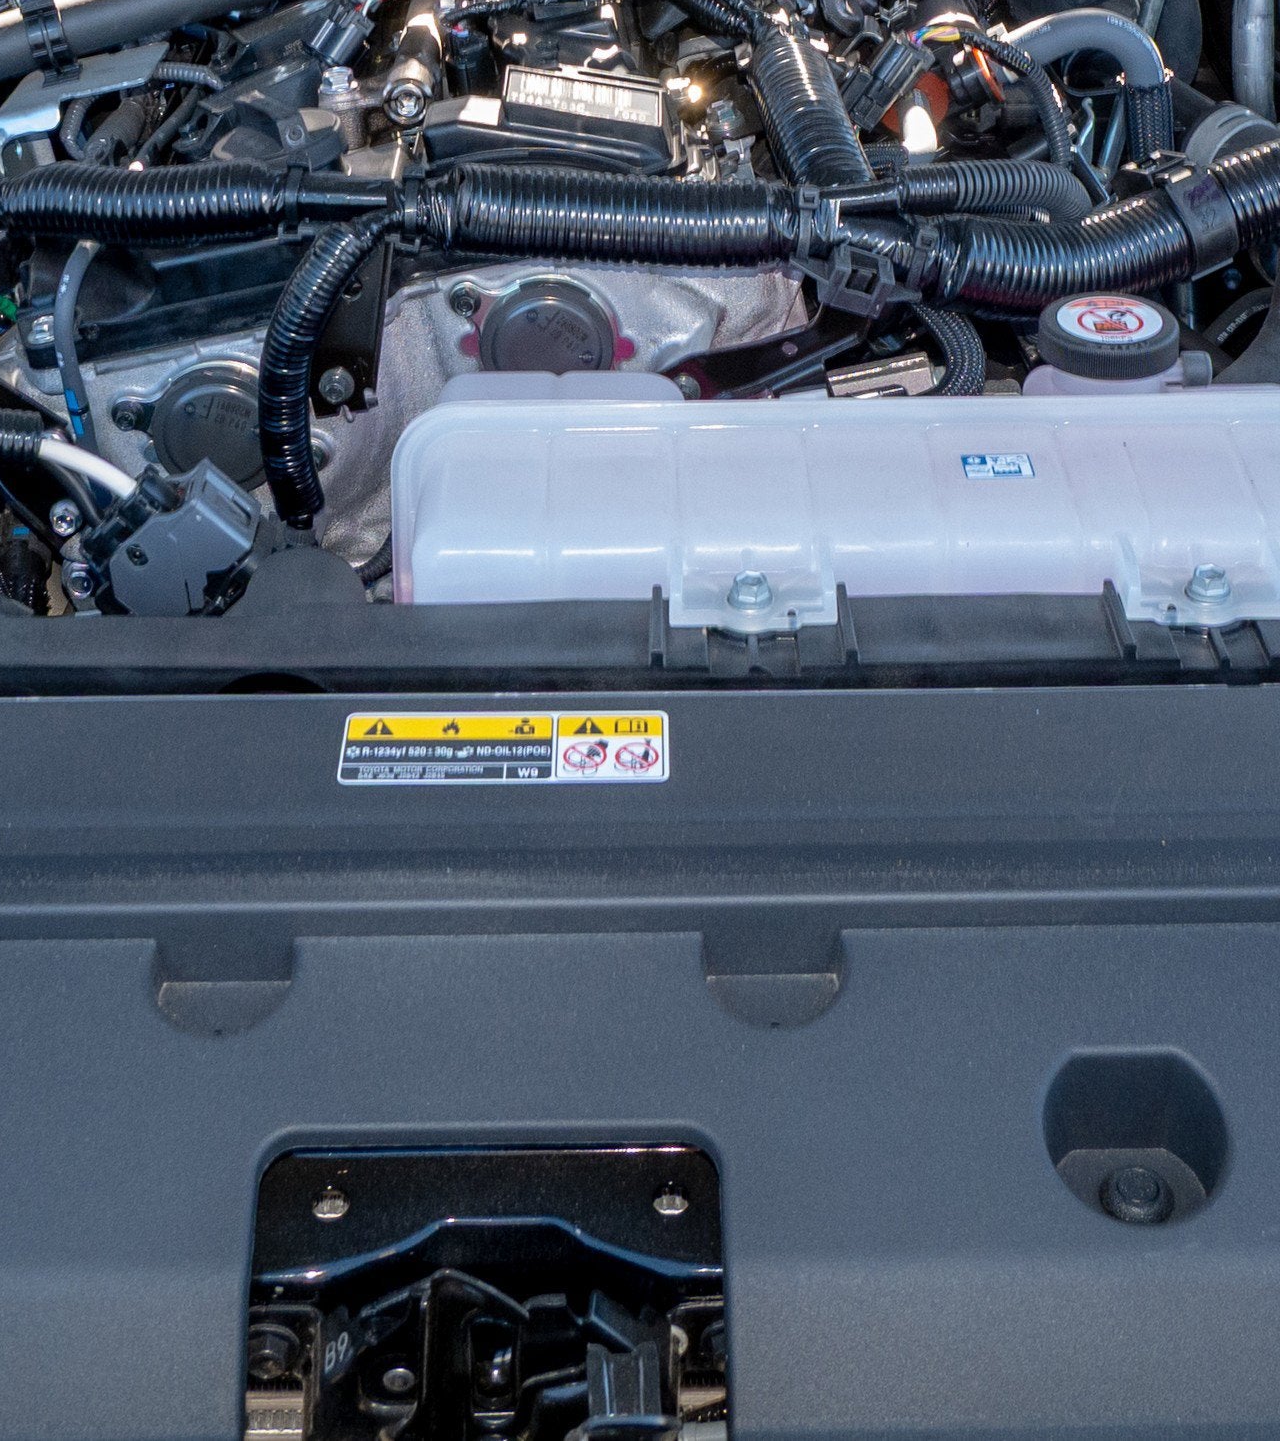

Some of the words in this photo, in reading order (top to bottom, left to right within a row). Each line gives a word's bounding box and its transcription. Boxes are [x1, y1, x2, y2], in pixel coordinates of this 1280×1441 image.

[359, 765, 390, 774] TOYOTA
[394, 765, 423, 774] MOTOR
[325, 1331, 349, 1374] B9
